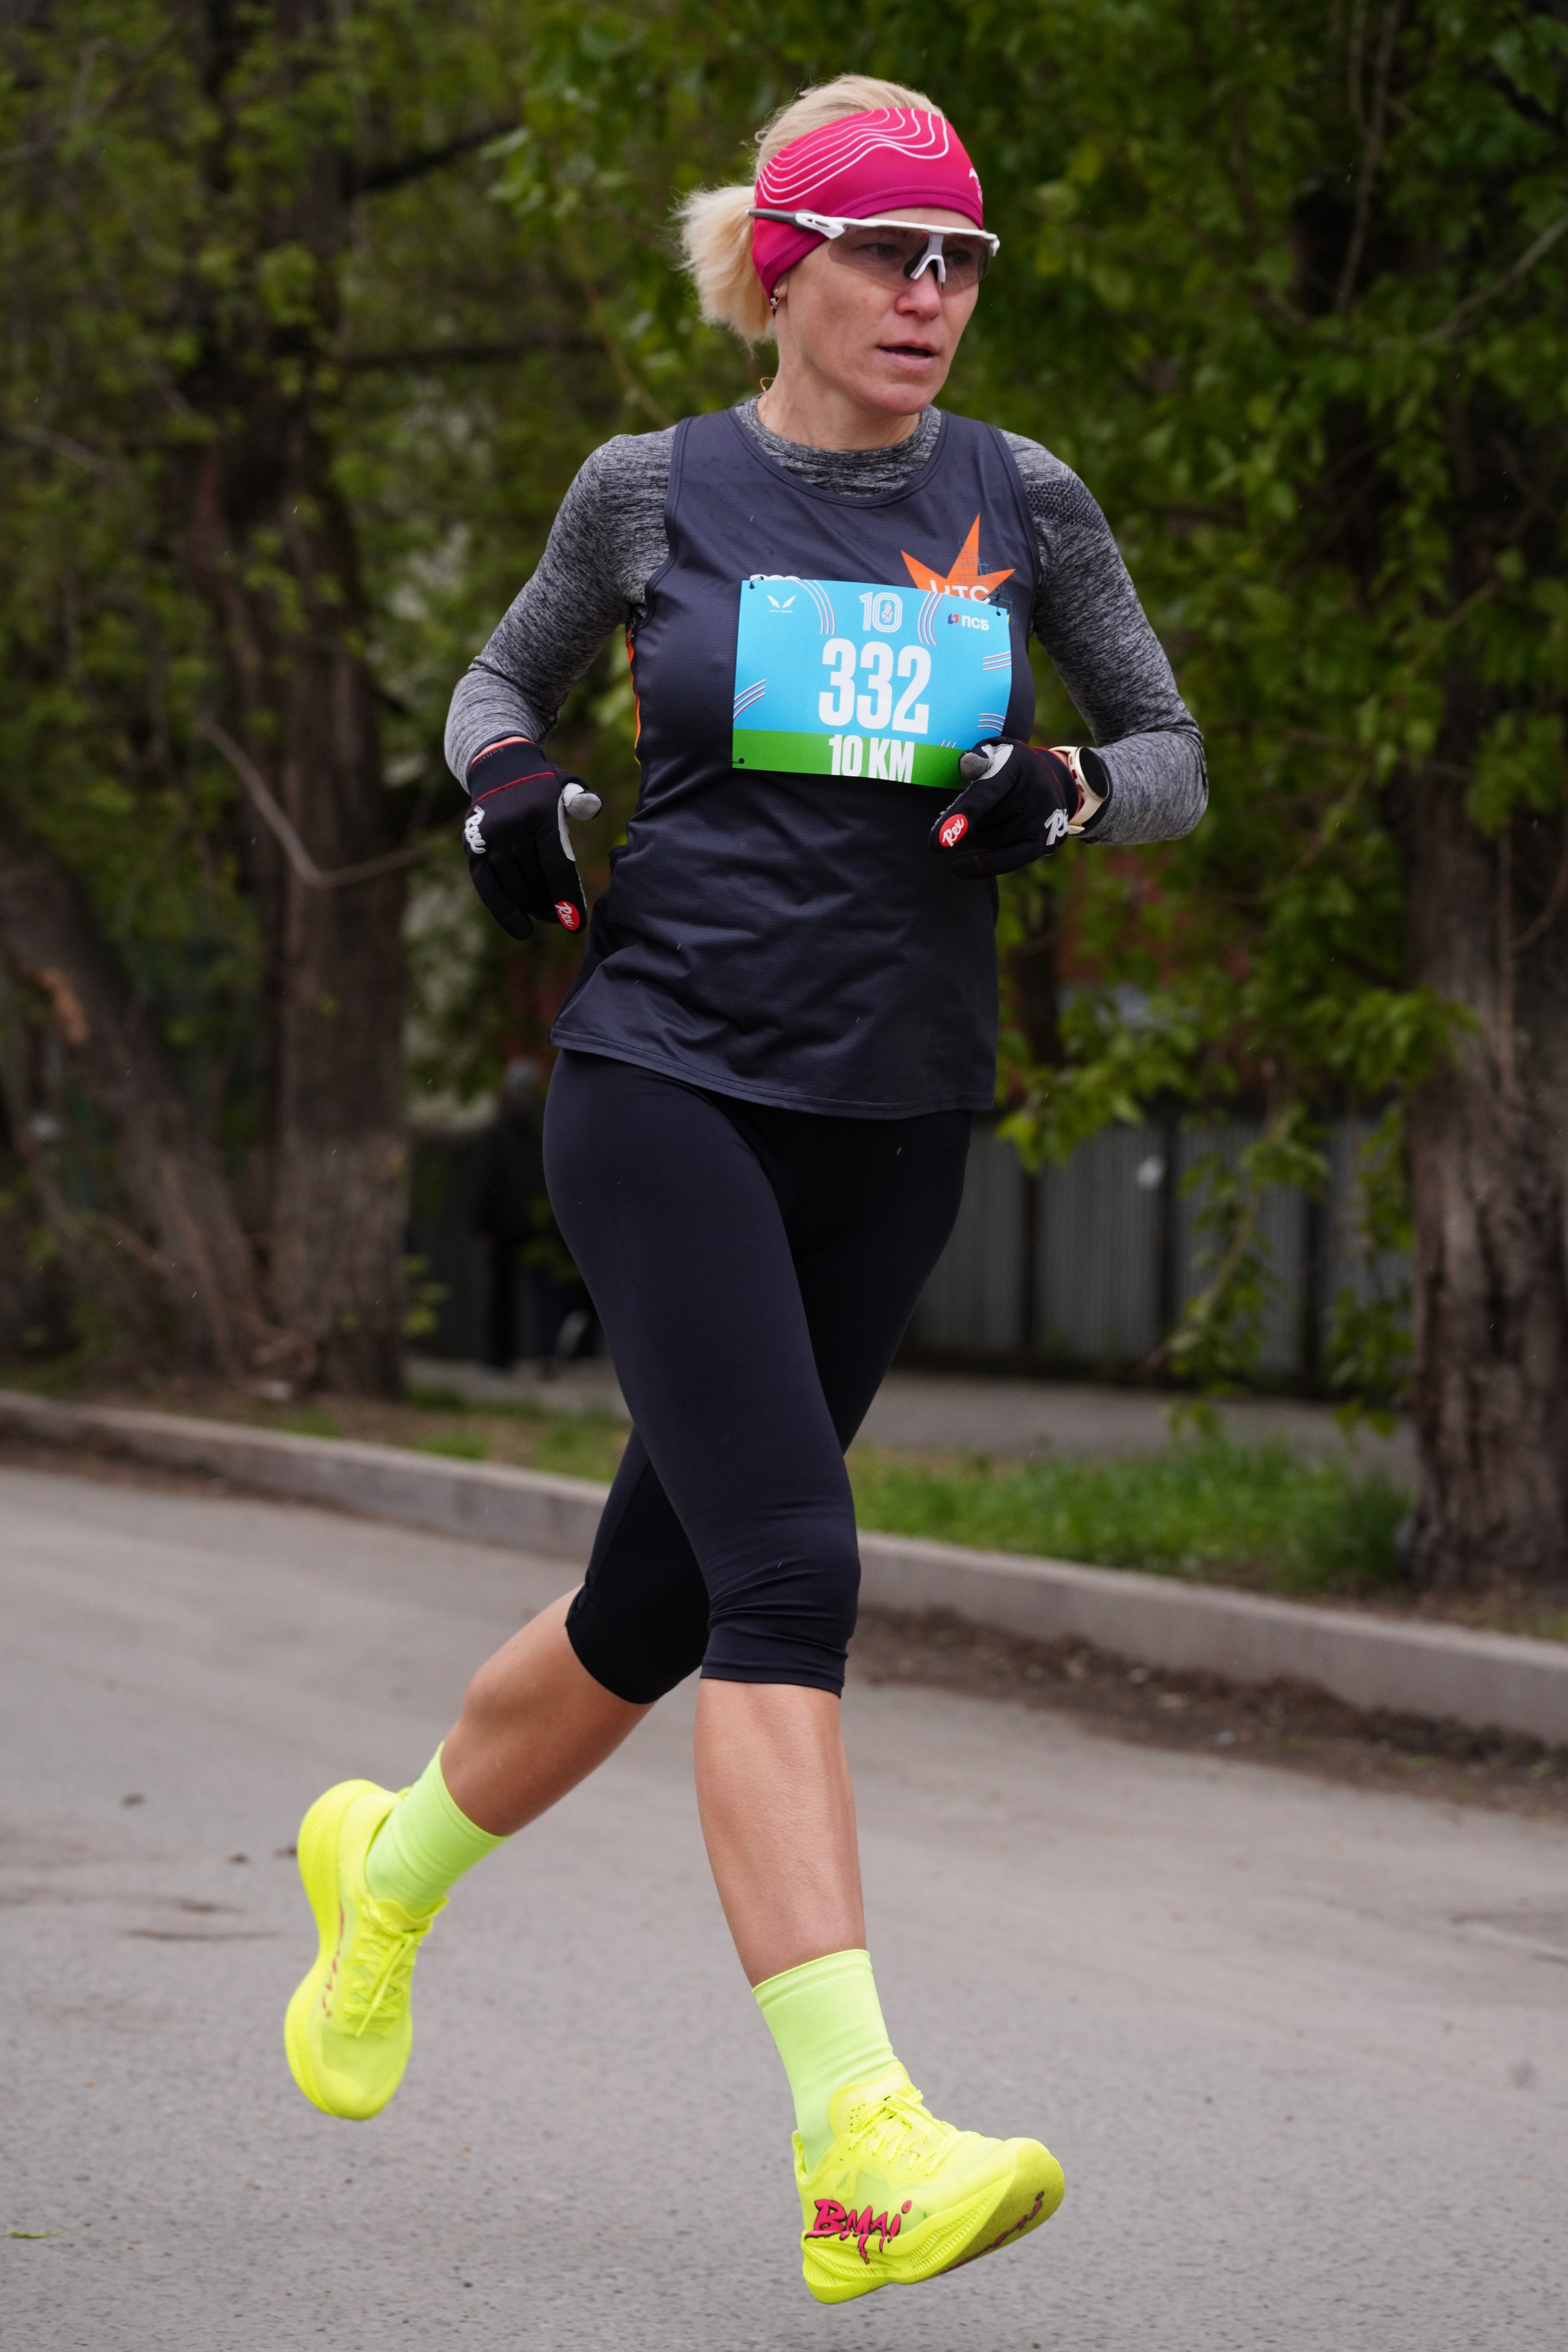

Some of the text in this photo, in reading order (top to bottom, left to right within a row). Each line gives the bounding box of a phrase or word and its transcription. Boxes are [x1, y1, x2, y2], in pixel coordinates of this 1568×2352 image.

[859, 591, 903, 633] 10
[961, 614, 990, 631] ПСБ
[818, 638, 932, 734] 332
[829, 734, 915, 783] 10 KM
